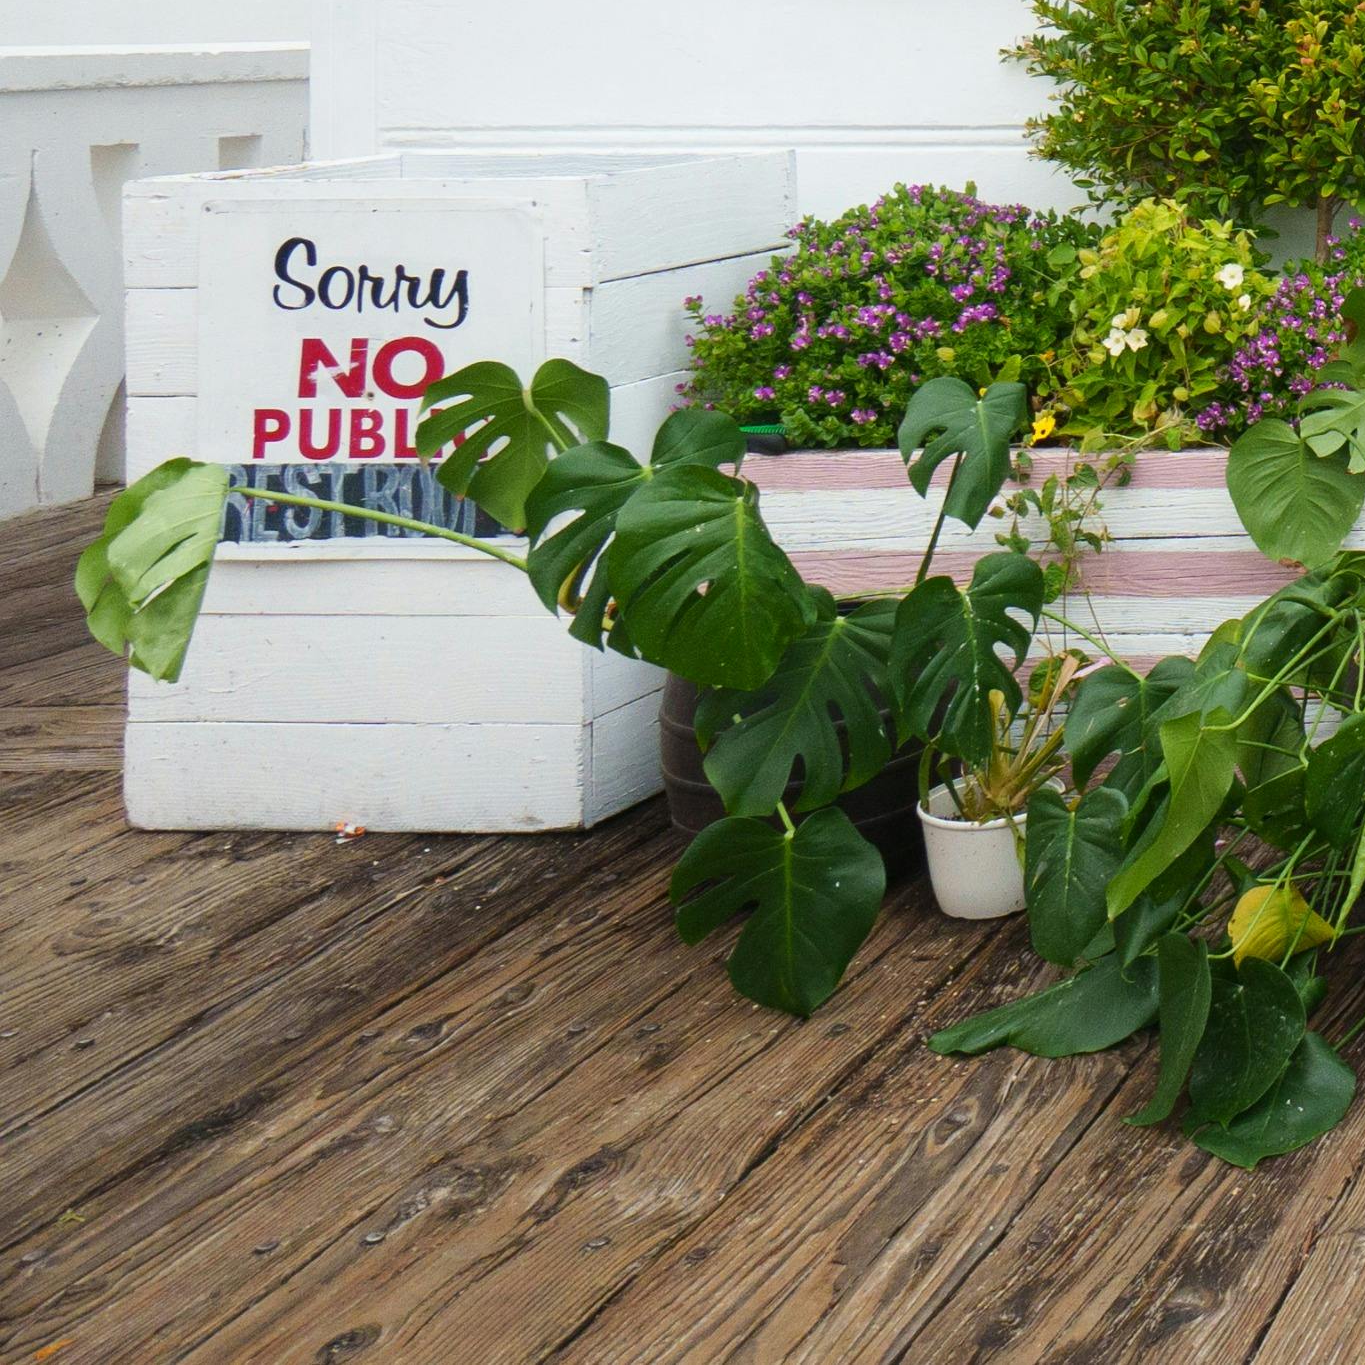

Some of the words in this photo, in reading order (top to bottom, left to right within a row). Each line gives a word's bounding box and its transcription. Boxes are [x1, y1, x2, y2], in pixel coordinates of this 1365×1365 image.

[273, 237, 470, 329] Sorry
[298, 336, 445, 399] NO
[252, 408, 488, 460] PUBL
